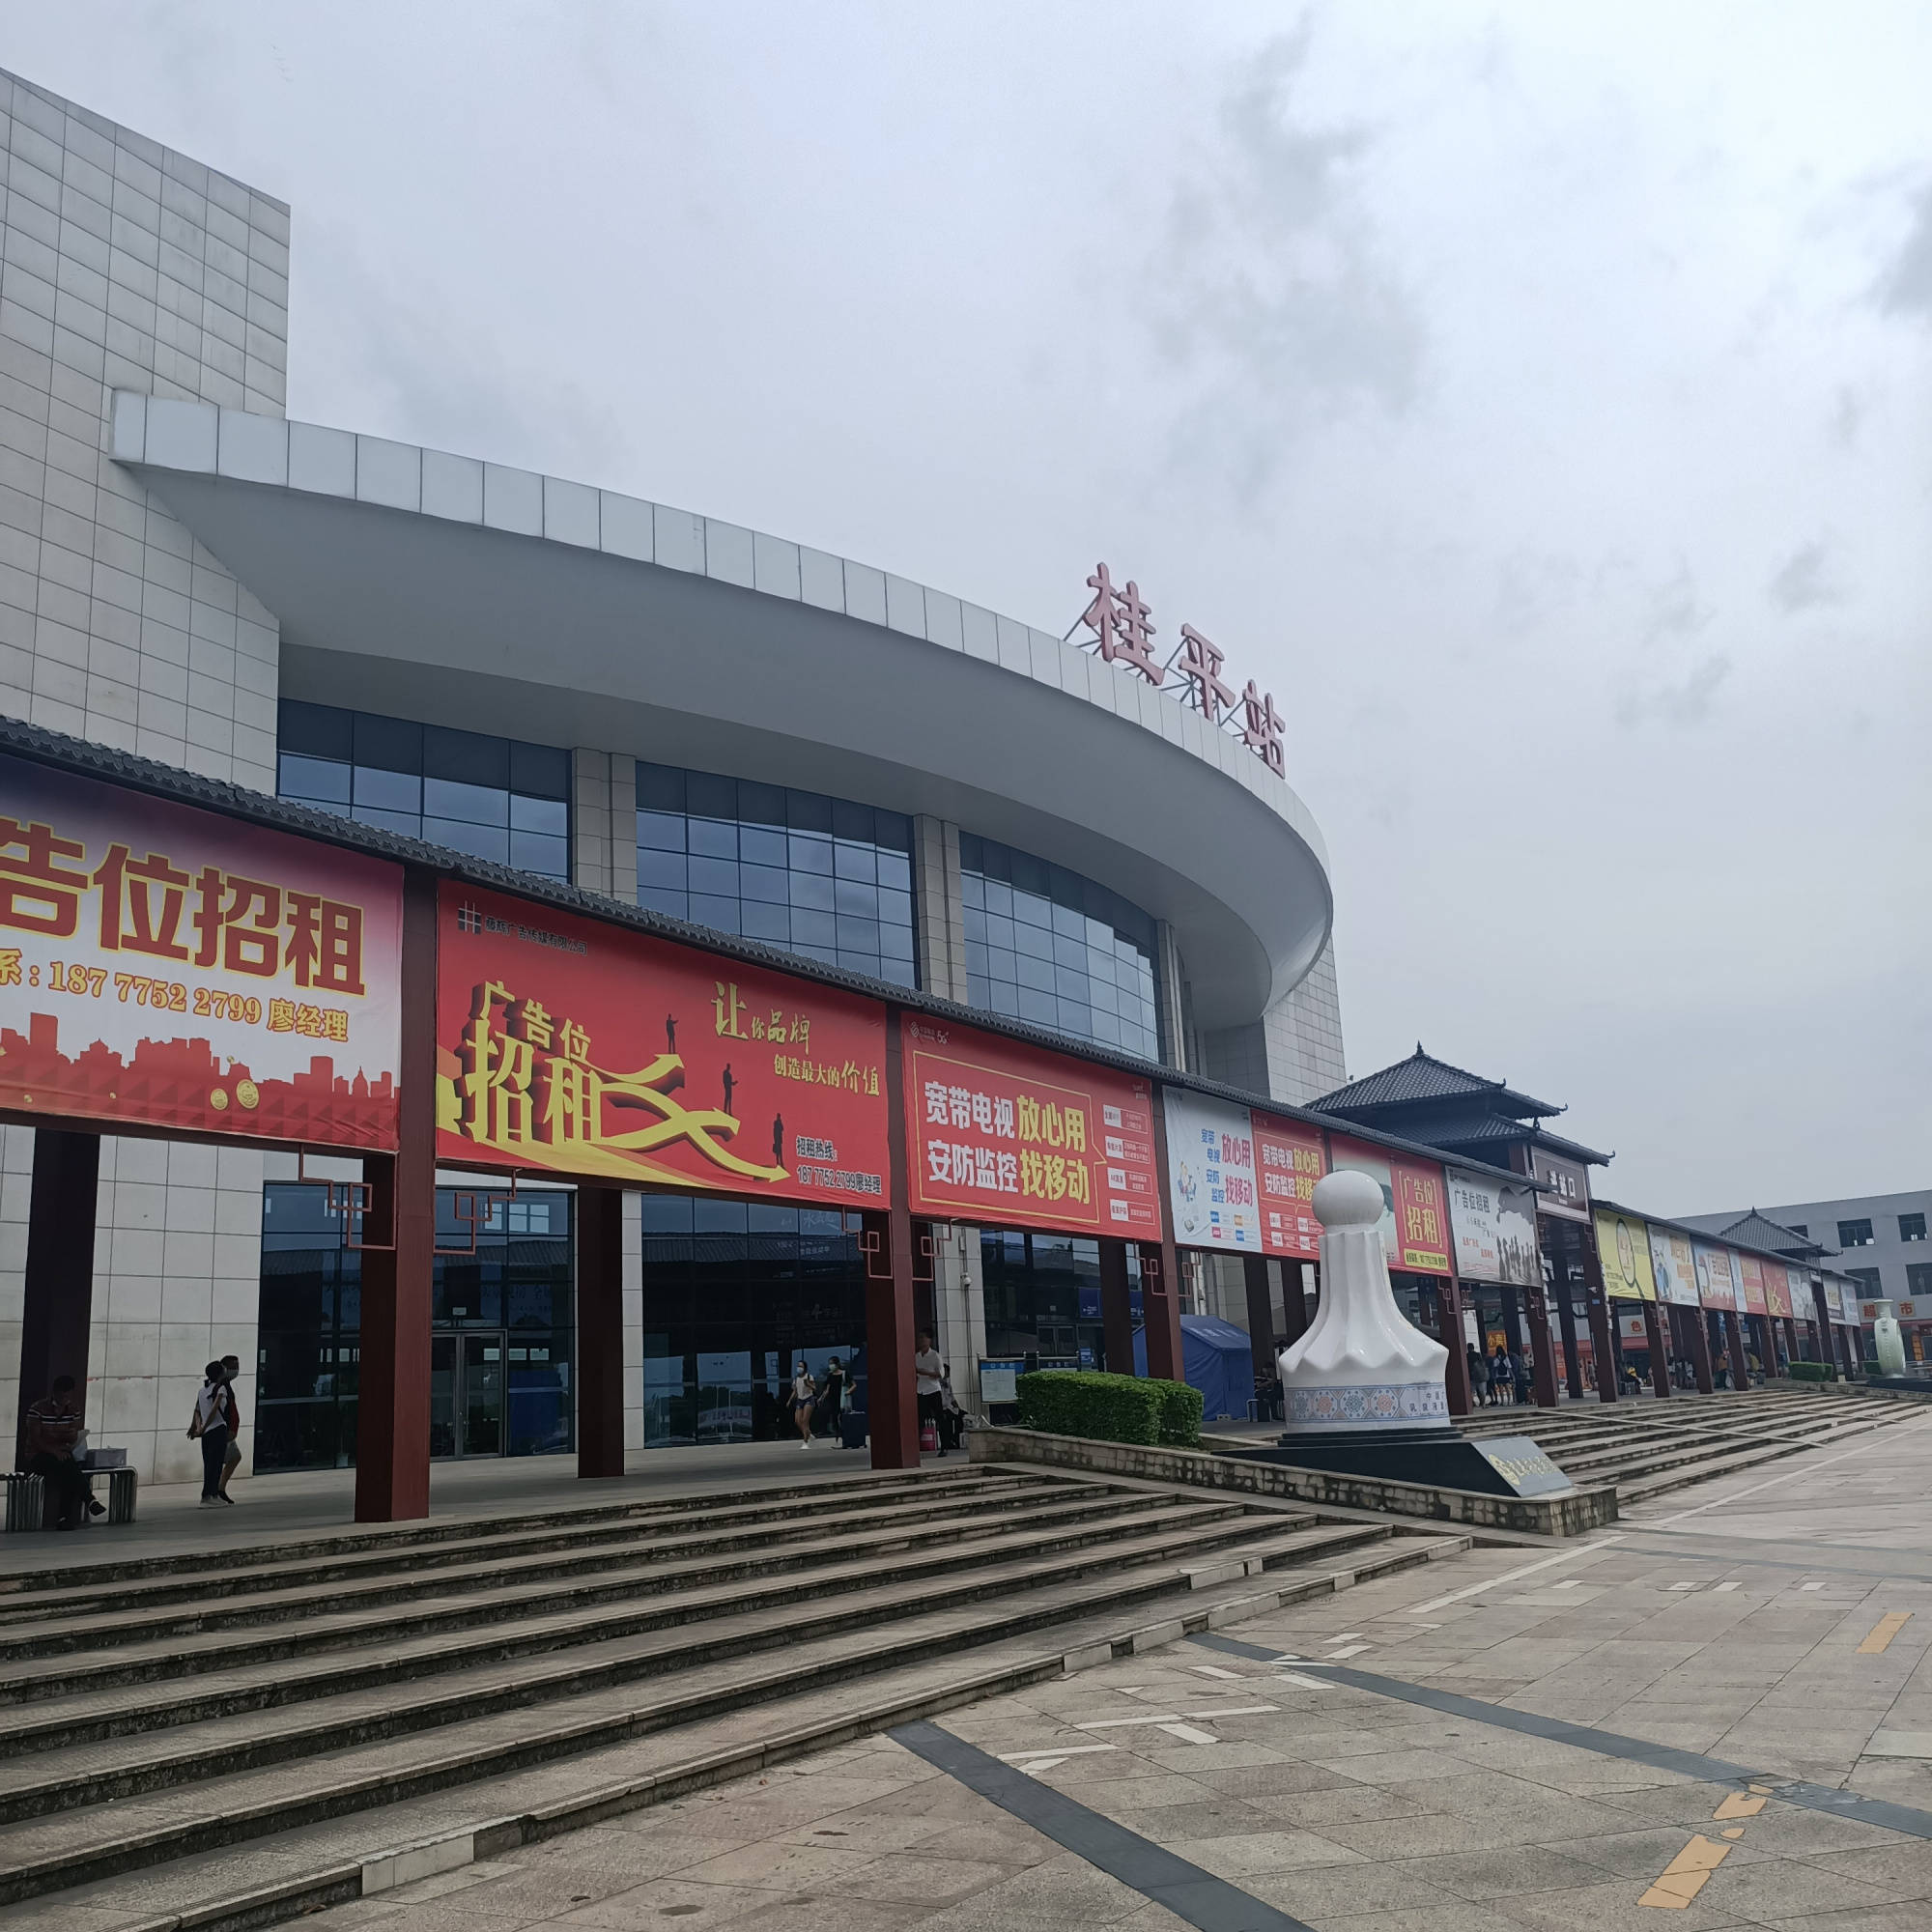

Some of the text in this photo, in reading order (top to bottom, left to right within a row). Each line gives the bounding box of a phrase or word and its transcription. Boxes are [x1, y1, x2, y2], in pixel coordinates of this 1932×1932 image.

[1082, 562, 1286, 780] 桂平站
[0, 815, 367, 997] 告位招租
[48, 960, 107, 998] 187
[114, 973, 187, 1012] 7752
[193, 987, 262, 1025] 2799
[267, 998, 349, 1042] 廖经理
[479, 980, 593, 1063] 广告位
[466, 1019, 604, 1147] 招租
[773, 1053, 880, 1097] 创造最大的价值
[924, 1081, 1087, 1152] 宽带电视 放心用
[927, 1139, 1091, 1205] 安防监控 找移动
[1221, 1133, 1251, 1169] 放心用
[1262, 1144, 1321, 1177] 宽带电视 放心用
[797, 1164, 812, 1185] 187
[814, 1166, 835, 1188] 7752
[1225, 1175, 1253, 1207] 找移动
[1295, 1175, 1319, 1202] 找移
[1404, 1176, 1435, 1206] 广告位
[1406, 1205, 1438, 1244] 招租
